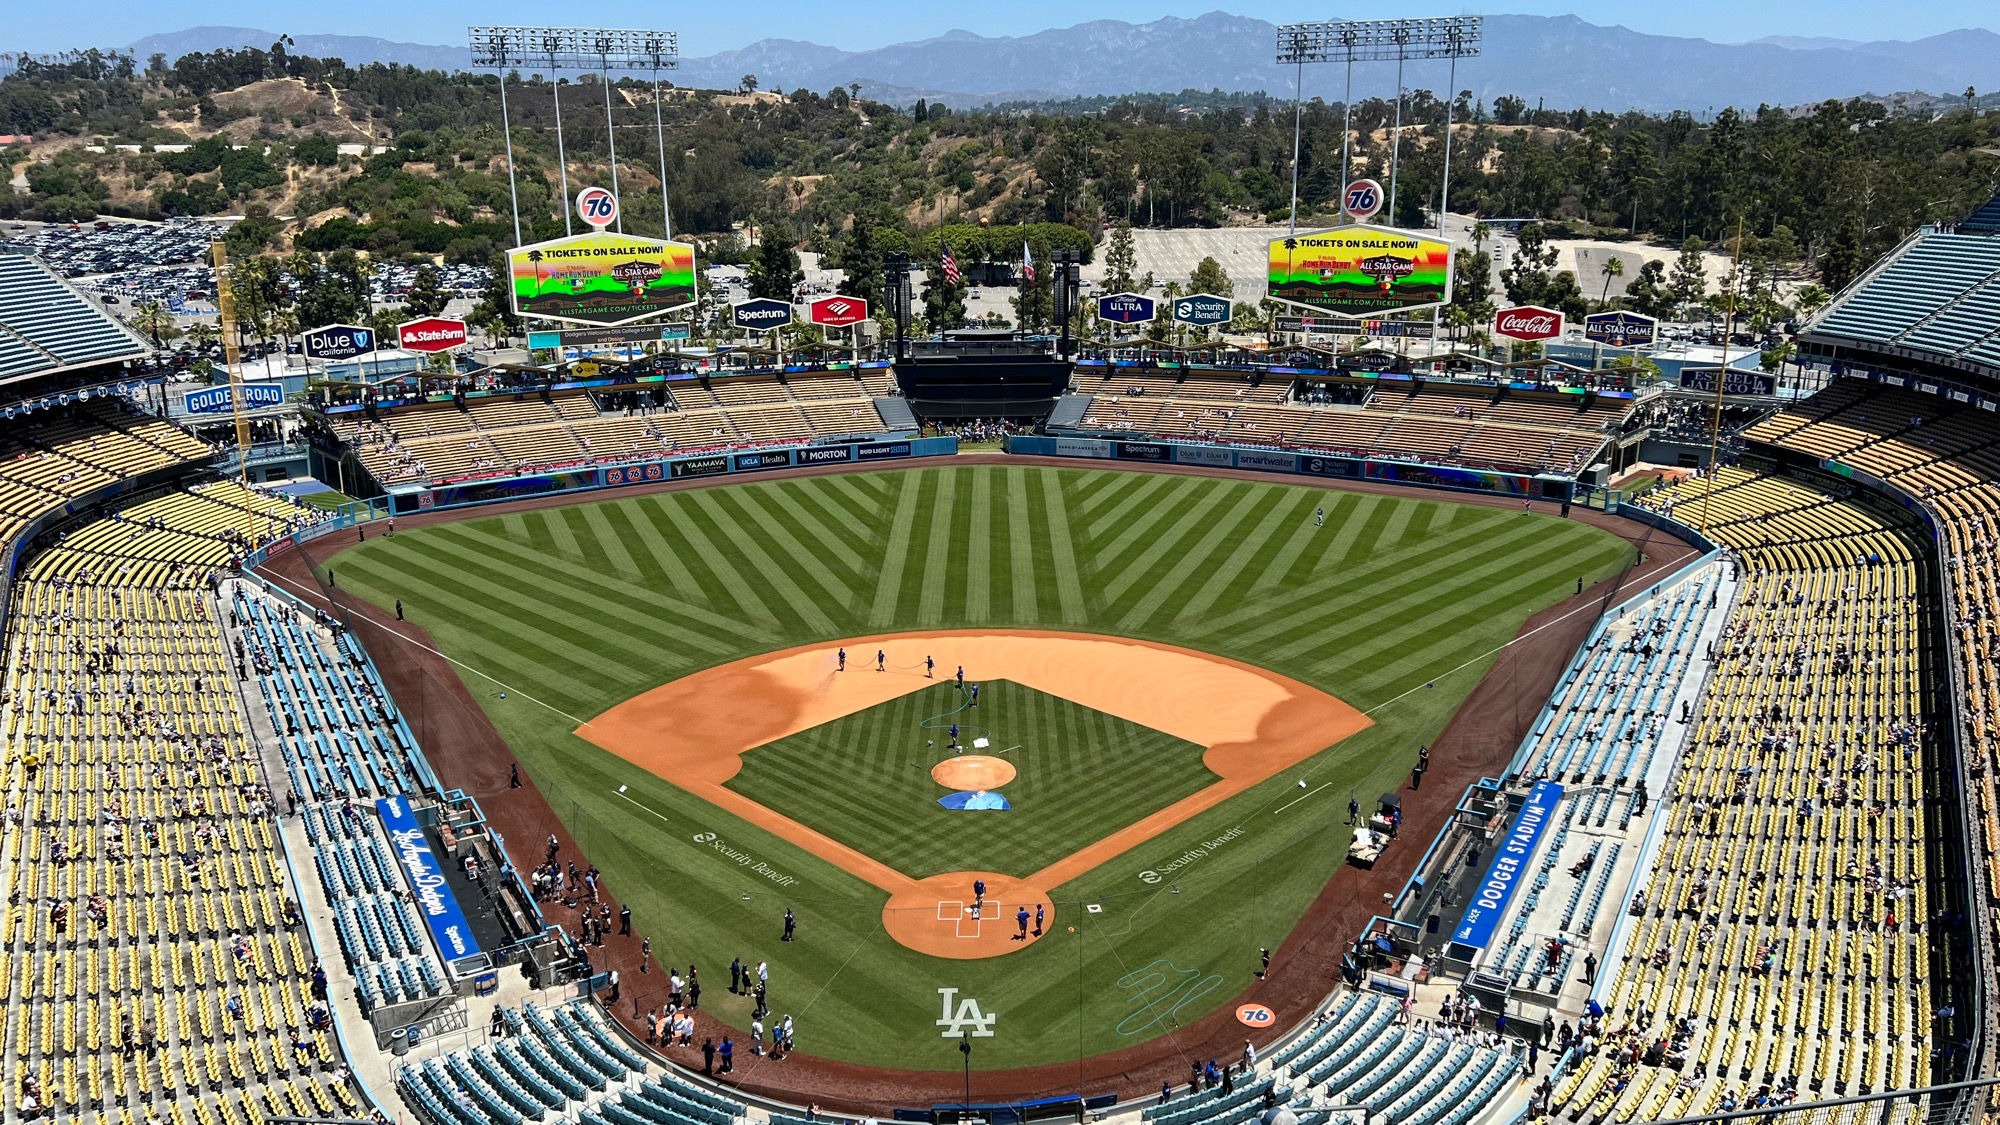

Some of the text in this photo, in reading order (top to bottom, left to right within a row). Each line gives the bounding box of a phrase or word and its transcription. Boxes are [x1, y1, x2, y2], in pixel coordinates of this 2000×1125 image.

[1348, 187, 1376, 210] 76
[585, 196, 612, 217] 76
[1300, 239, 1418, 249] TICKETS ON SALE NOW!
[545, 246, 663, 258] TICKETS ON SALE NOW!
[1359, 262, 1373, 270] ALL
[1374, 262, 1391, 270] STAR
[1392, 262, 1415, 271] GAME
[610, 267, 663, 277] ALL STAR GAME
[1110, 303, 1142, 311] ULTRA
[1195, 302, 1225, 311] Security
[1304, 297, 1403, 307] ALLSTARGAME.COM/TICKETS
[559, 304, 658, 316] ALLSTARGAME.COM/TICKETS
[738, 309, 784, 321] Spectrum
[1195, 311, 1221, 319] Benefit
[1501, 314, 1556, 334] Coca-Cola
[1588, 324, 1652, 336] ALL STAR GAME
[311, 334, 350, 350] blue
[319, 347, 356, 357] california
[191, 387, 279, 411] GOLDEN ROAD
[890, 445, 909, 453] SELTZER
[1125, 444, 1160, 453] Spectrum
[762, 455, 786, 464] Health
[810, 450, 847, 460] MORTON
[1240, 455, 1293, 467] smartwater
[1325, 460, 1349, 469] Security
[629, 470, 640, 478] 76
[648, 467, 659, 476] 76
[1325, 466, 1346, 474] Benefit
[610, 472, 620, 480] 76
[421, 496, 431, 504] 76
[1156, 826, 1245, 875] Security Benefit
[709, 840, 794, 886] Security Benefit
[1478, 857, 1520, 910] DODGER
[1507, 806, 1546, 854] STADIUM
[393, 829, 447, 916] Los Angeles Dodgers
[445, 925, 466, 955] Spectrum
[935, 987, 996, 1038] LA
[1242, 1009, 1270, 1022] 76
